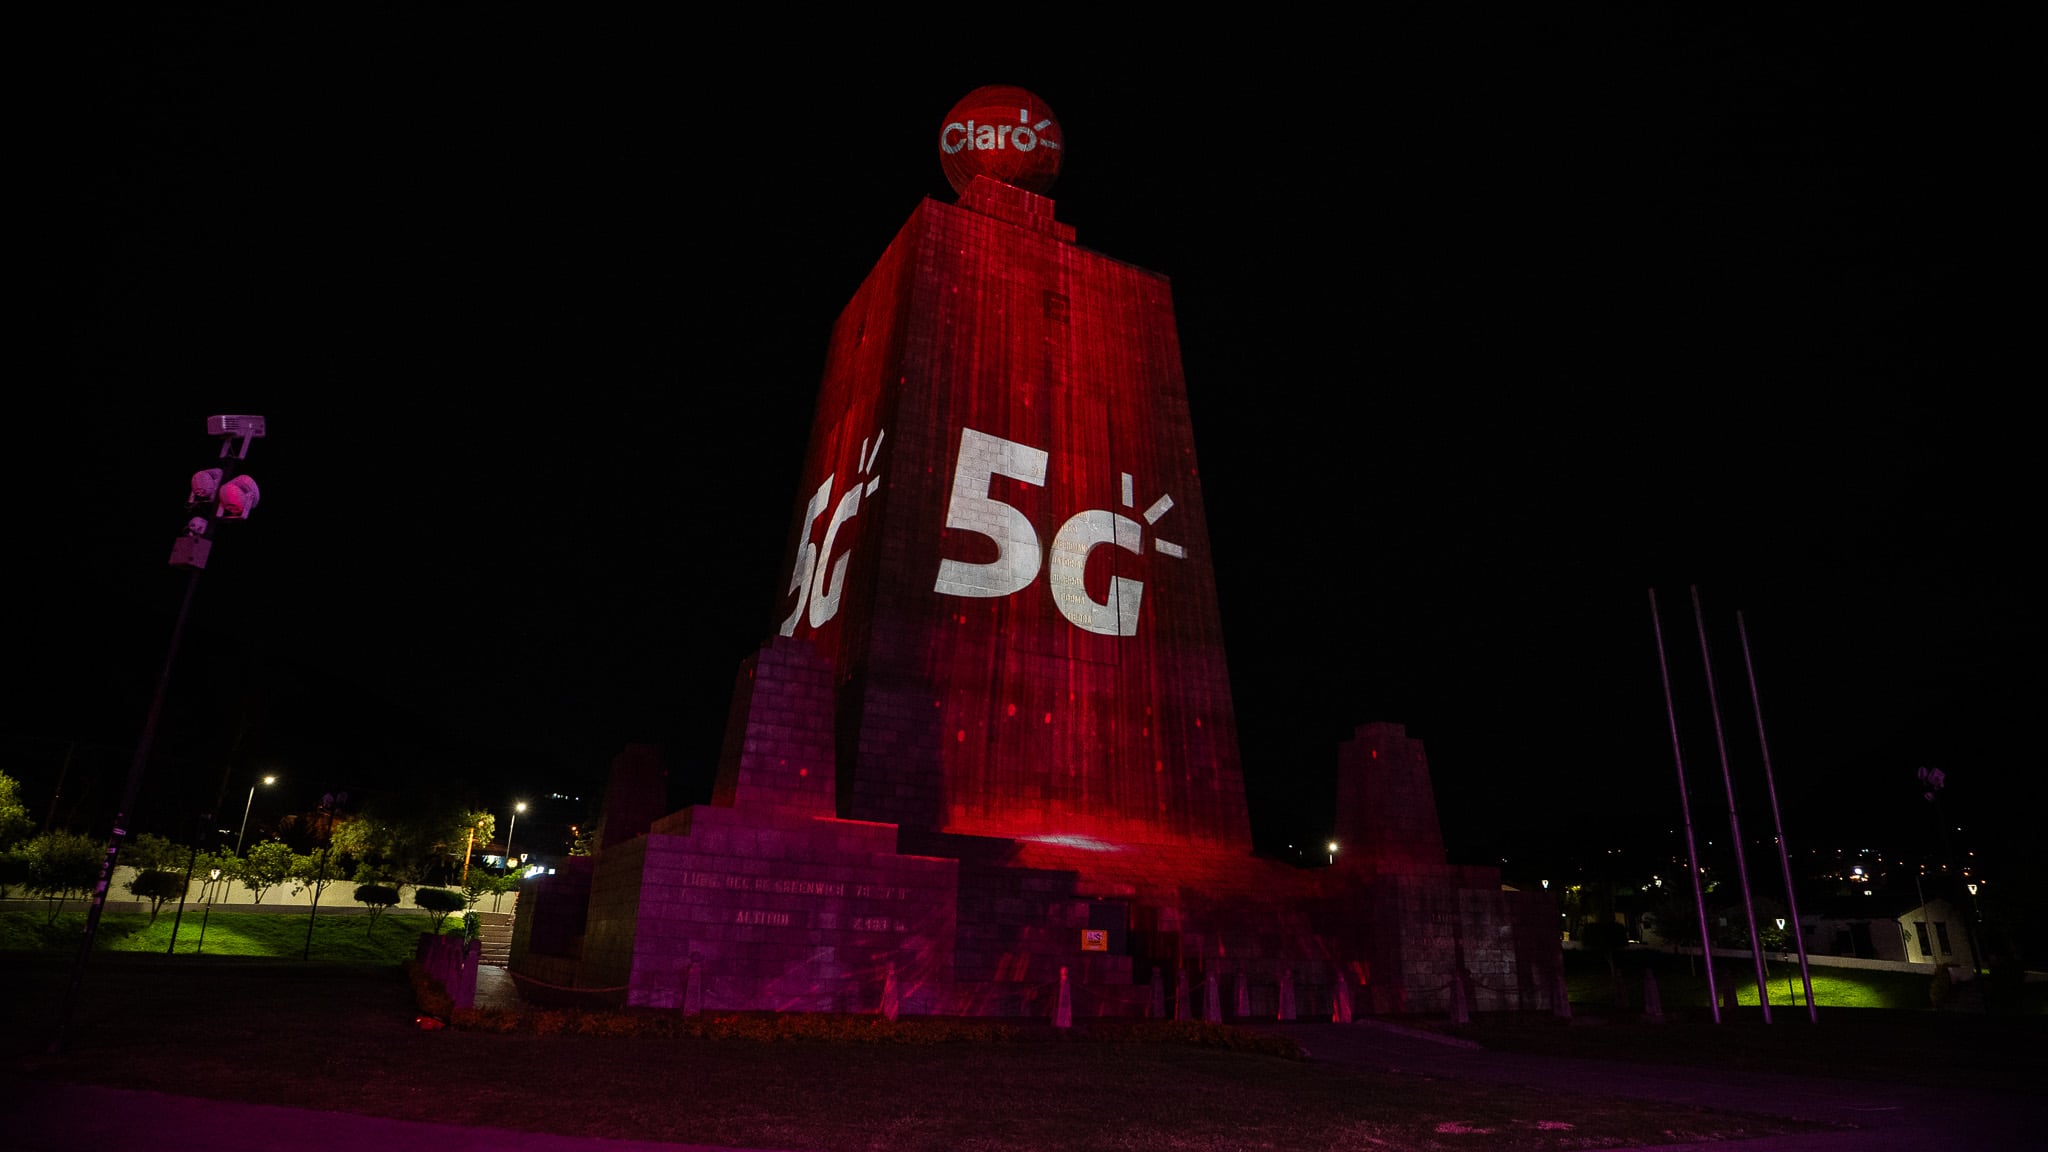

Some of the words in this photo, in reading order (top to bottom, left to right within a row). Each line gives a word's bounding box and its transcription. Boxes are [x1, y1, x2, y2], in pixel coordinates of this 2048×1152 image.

[941, 120, 1038, 154] Claro
[779, 472, 864, 638] 5G
[933, 427, 1144, 636] 5G
